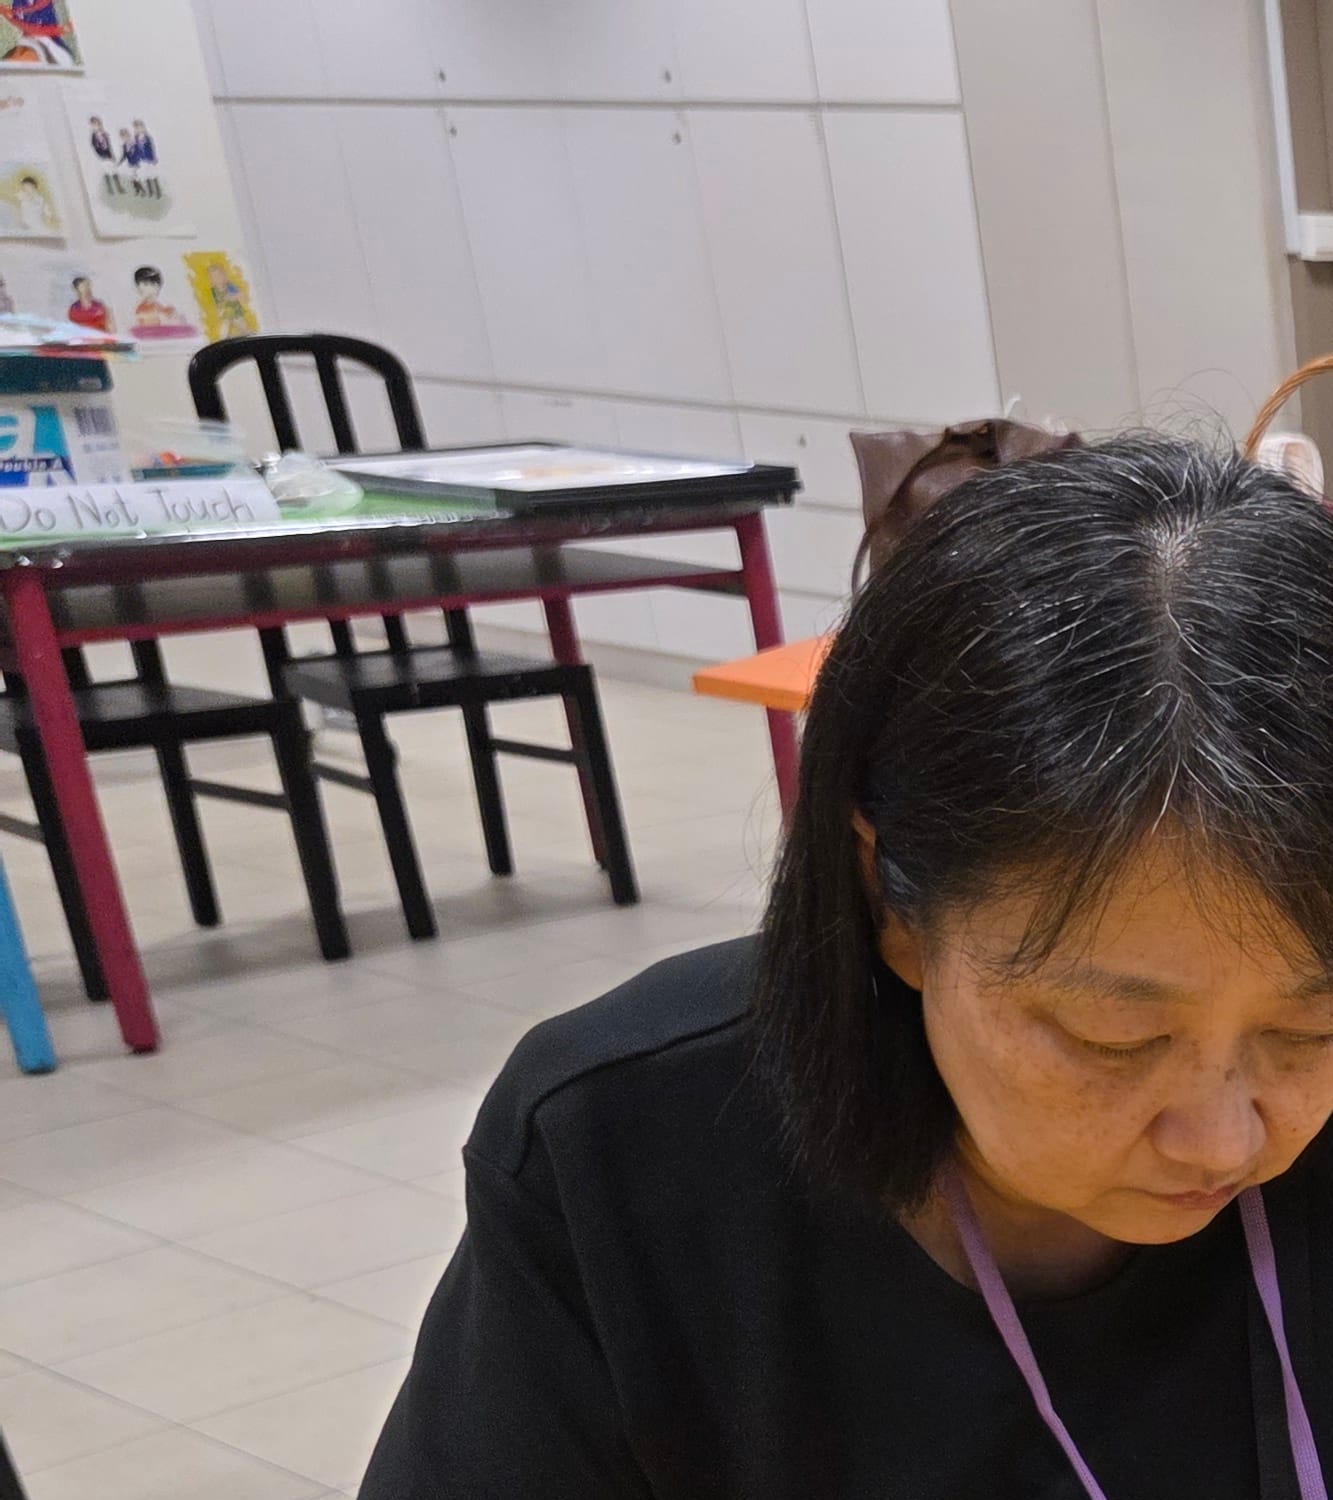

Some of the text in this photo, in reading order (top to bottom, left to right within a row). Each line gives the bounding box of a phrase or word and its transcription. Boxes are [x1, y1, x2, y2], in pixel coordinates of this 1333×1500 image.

[0, 487, 255, 532] Do Not Touch
